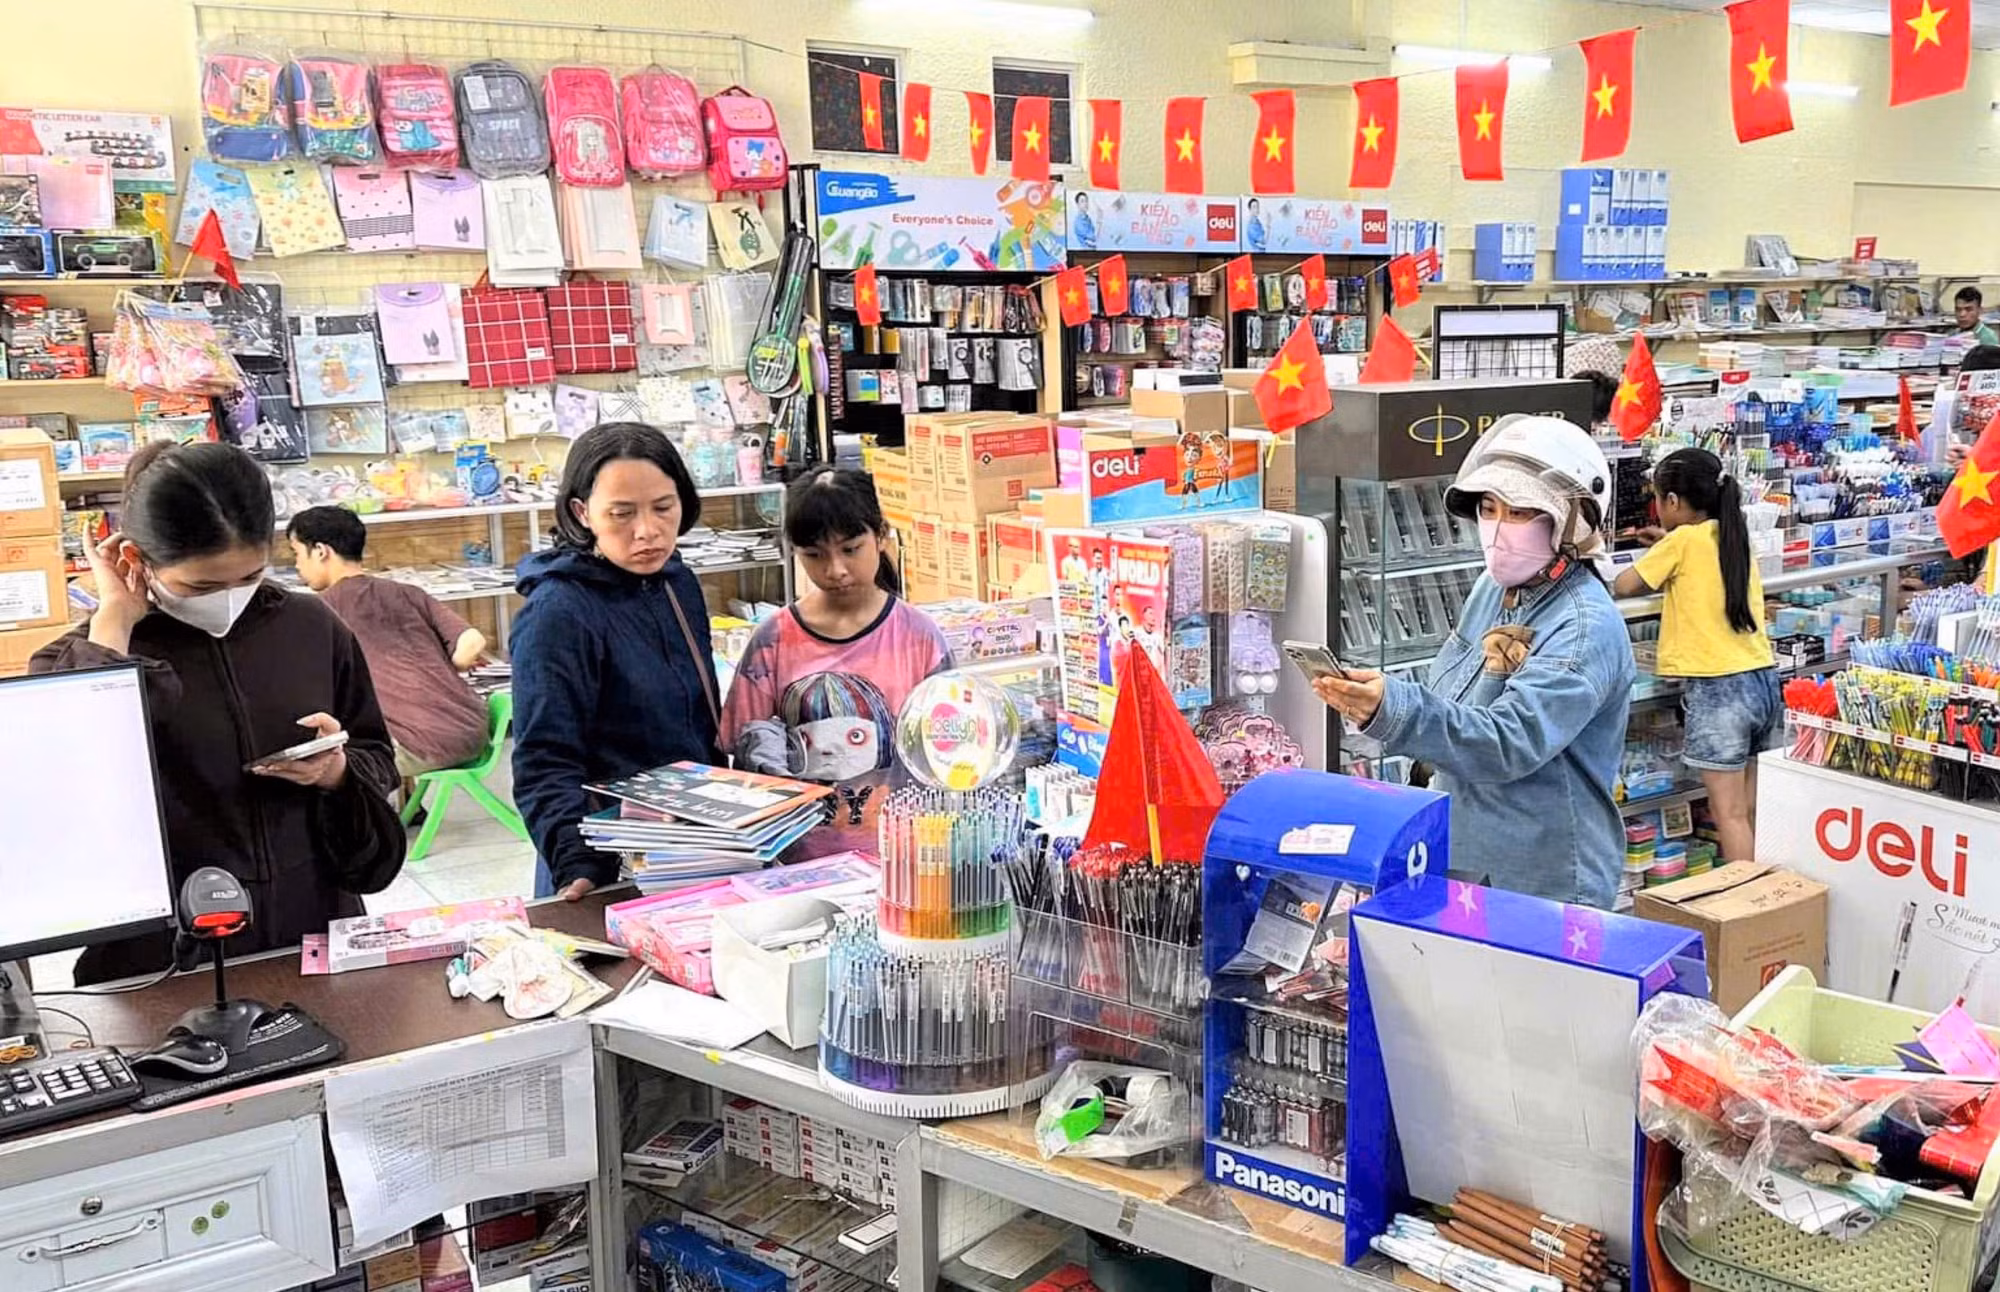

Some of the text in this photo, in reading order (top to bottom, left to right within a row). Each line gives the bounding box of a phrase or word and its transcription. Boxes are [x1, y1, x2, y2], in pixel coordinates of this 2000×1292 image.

[84, 114, 102, 122] CAR
[488, 119, 520, 131] SPACE
[892, 213, 994, 227] Everyone's Choice
[1209, 217, 1234, 229] deli
[1363, 221, 1386, 233] deli
[1092, 455, 1140, 478] deli
[1815, 806, 1969, 898] deli
[1215, 1151, 1346, 1217] Panasoni
